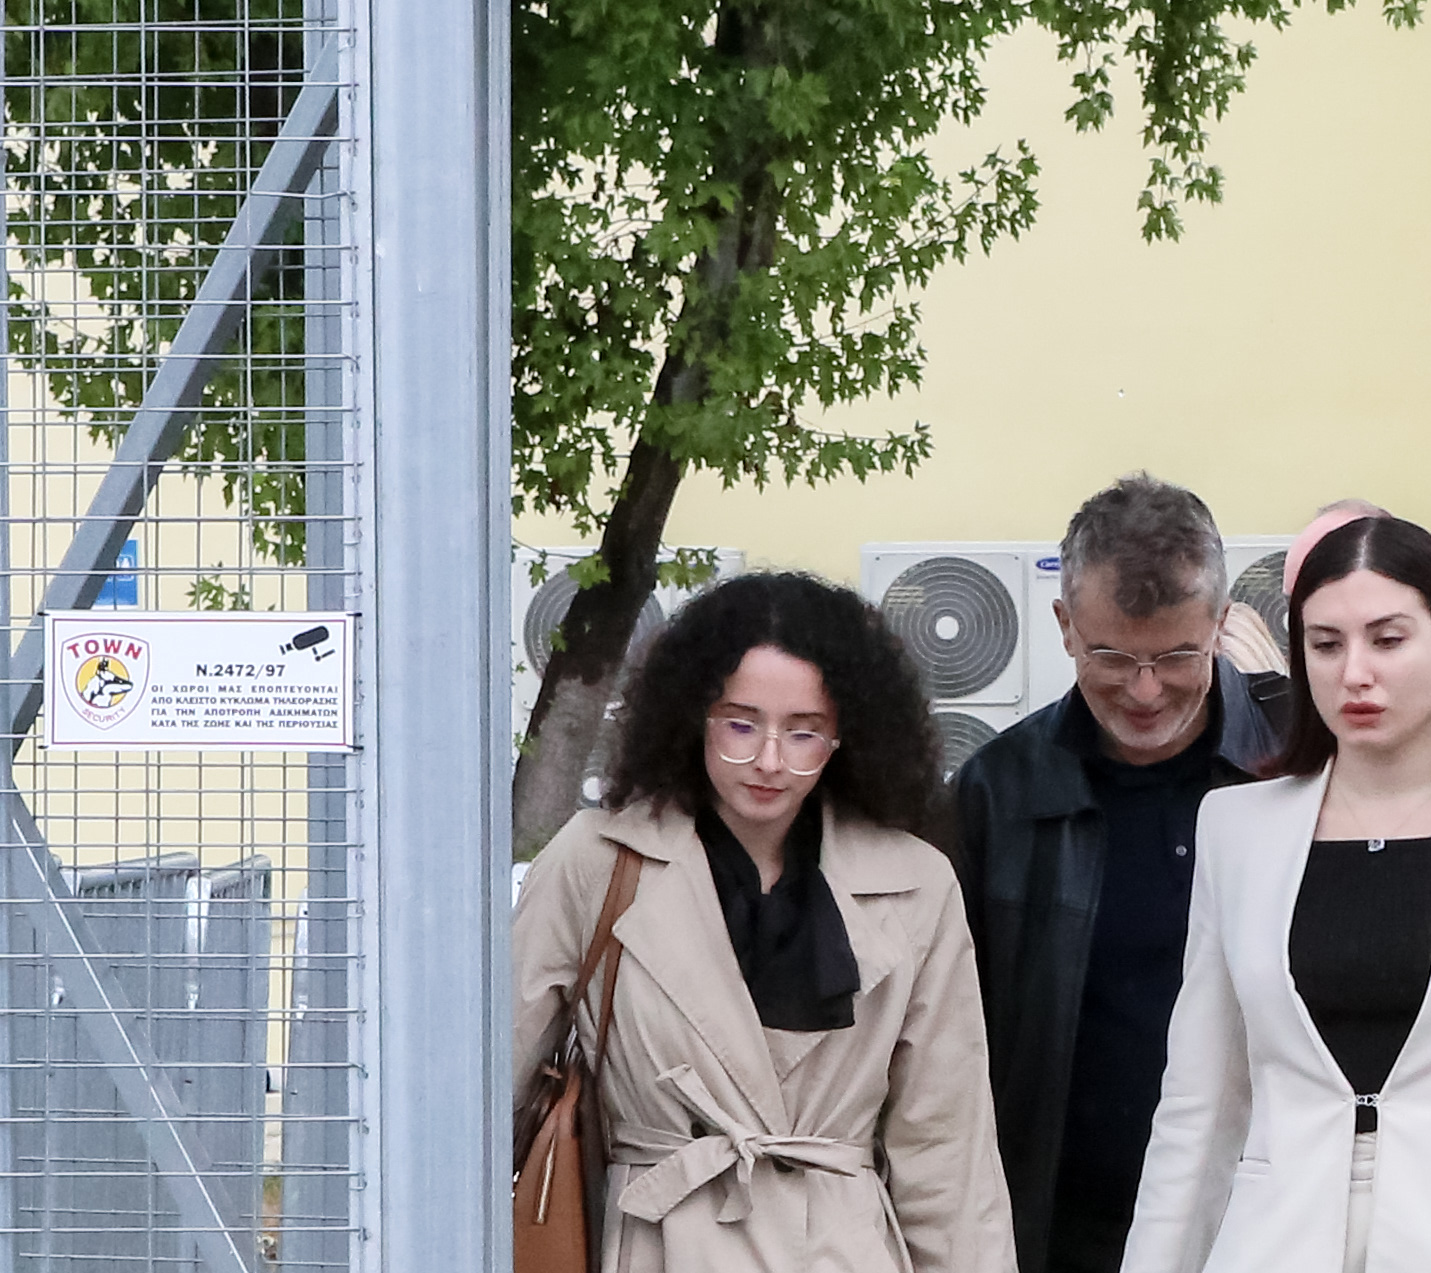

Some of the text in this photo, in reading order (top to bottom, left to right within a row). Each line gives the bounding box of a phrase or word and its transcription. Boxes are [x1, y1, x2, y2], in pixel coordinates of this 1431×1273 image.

[66, 638, 143, 661] TOWN
[195, 663, 286, 680] Ν.2472/97
[150, 685, 339, 694] ΟΙ ΧΩΡΟΙ ΜΑΣ ΕΠΟΠΤΕΥΟΝΤΑΙ
[150, 696, 173, 705] ΑΠΟ
[150, 708, 167, 716] ΓΙΑ
[175, 708, 196, 716] ΤΗΝ
[150, 719, 177, 728] ΚΑΤΑ
[234, 719, 252, 728] ΚΑΙ
